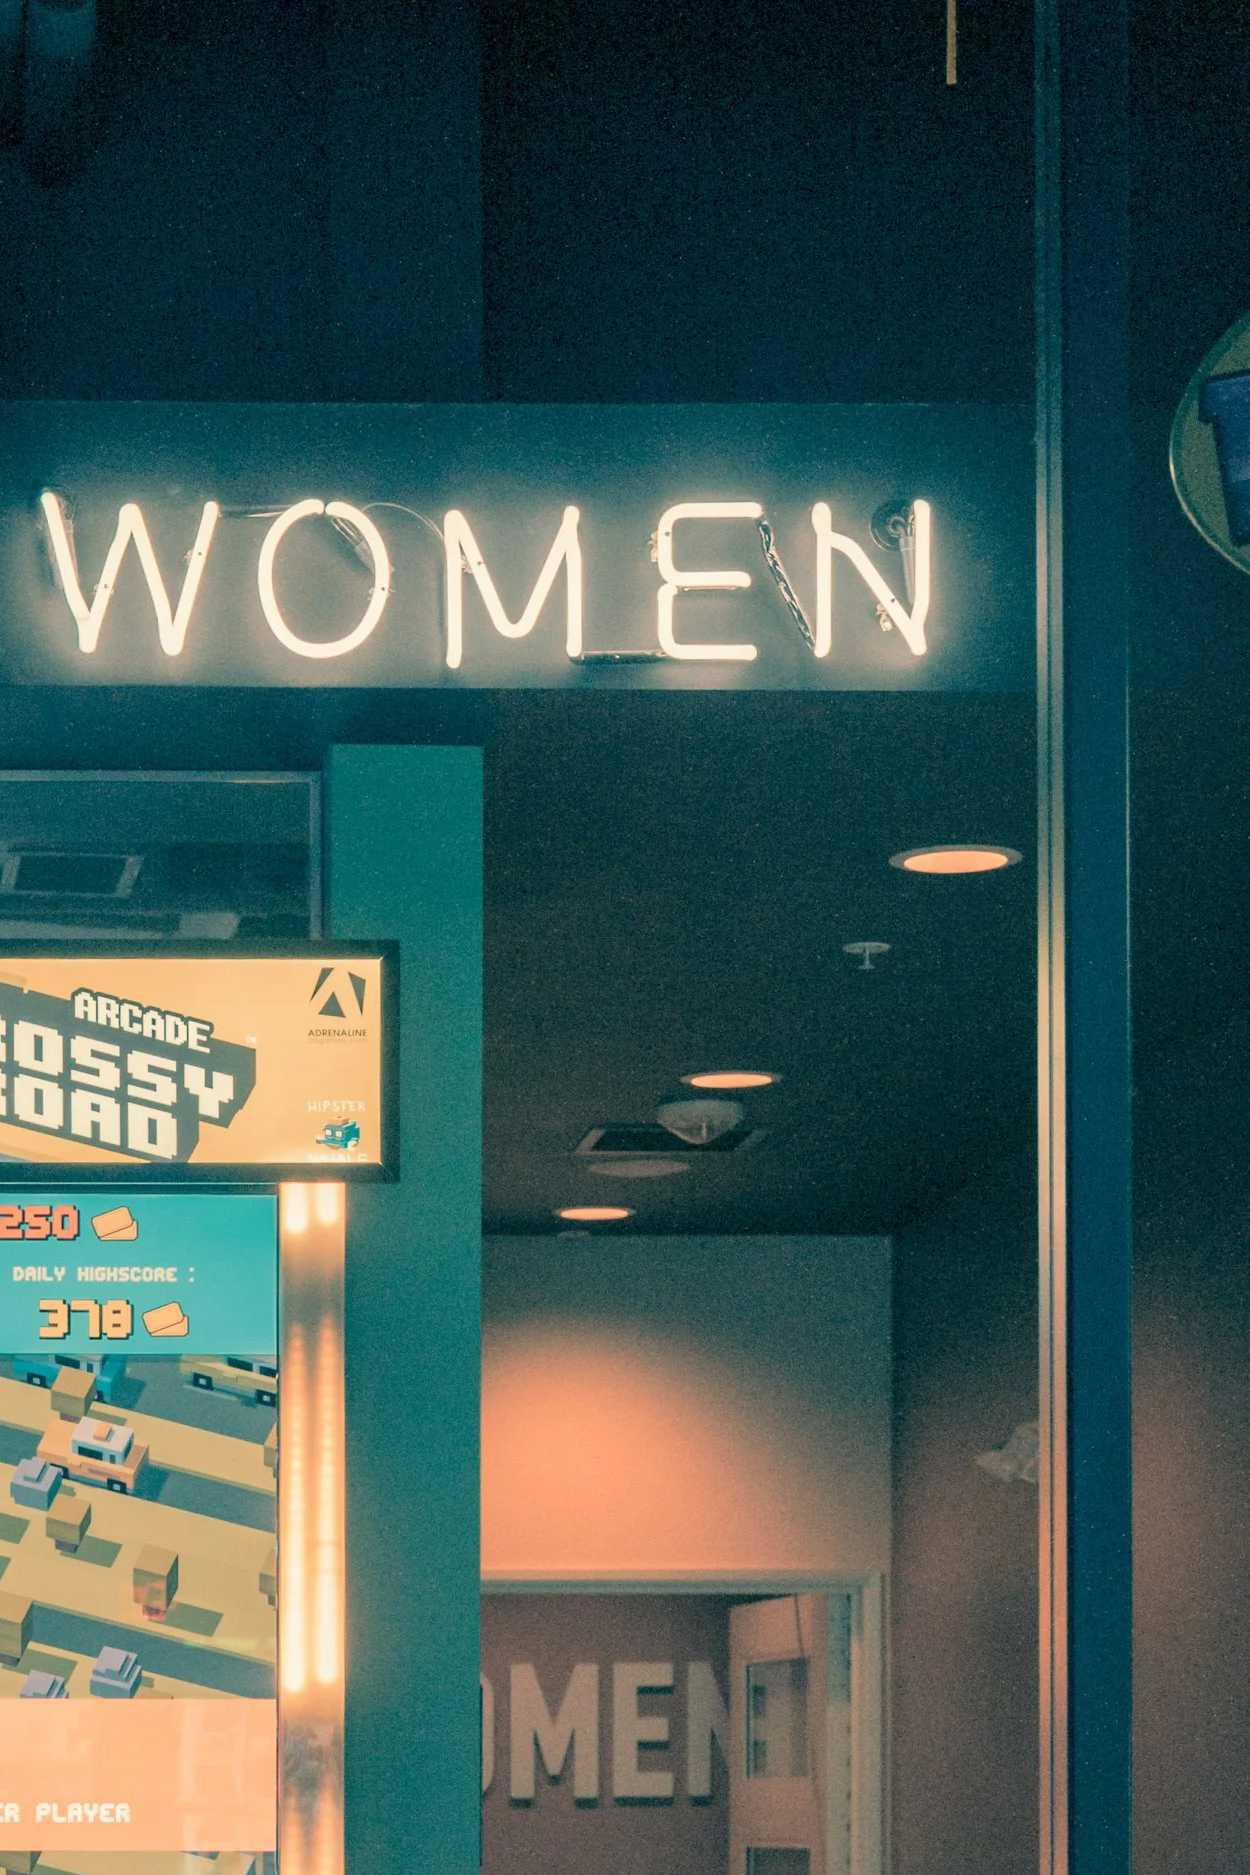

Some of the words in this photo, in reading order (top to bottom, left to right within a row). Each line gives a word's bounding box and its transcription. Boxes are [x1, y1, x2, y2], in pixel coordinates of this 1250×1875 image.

[40, 490, 931, 668] WOMEN
[73, 989, 211, 1055] ARCADE
[308, 1029, 367, 1037] ADRENALINE
[307, 1100, 367, 1113] HIPSTER
[12, 1266, 66, 1282] DAILY
[77, 1267, 177, 1282] HIGHSCORE
[38, 1299, 134, 1340] 378
[481, 1660, 731, 1800] MEN
[36, 1802, 131, 1823] PLAYER
